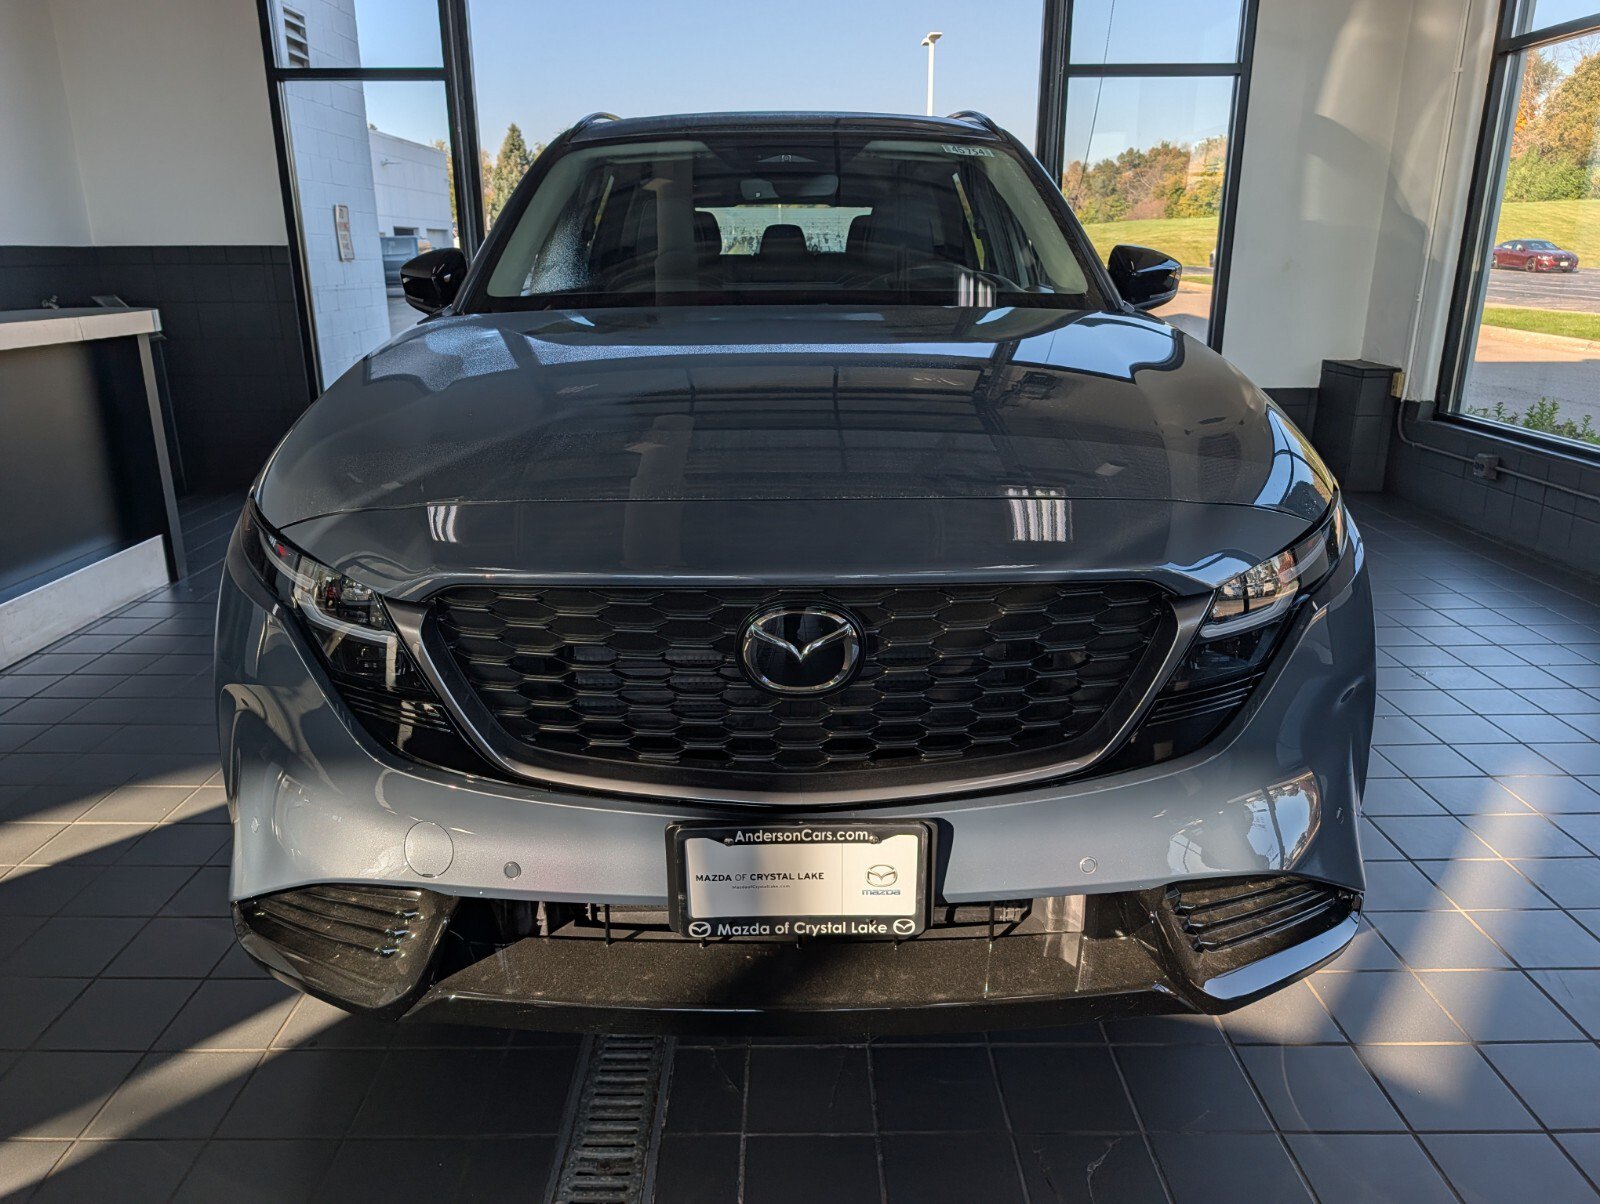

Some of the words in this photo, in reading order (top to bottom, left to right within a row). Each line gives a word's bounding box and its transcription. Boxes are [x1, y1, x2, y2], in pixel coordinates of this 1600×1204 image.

[735, 829, 869, 842] AndersonCars.com
[695, 874, 732, 882] MAZDA
[734, 873, 747, 881] OF
[749, 873, 795, 881] CRYSTAL
[797, 872, 825, 880] LAKE
[717, 923, 770, 935] Mazda
[774, 921, 790, 934] of
[793, 920, 846, 937] Crystal
[851, 920, 888, 934] Lake
